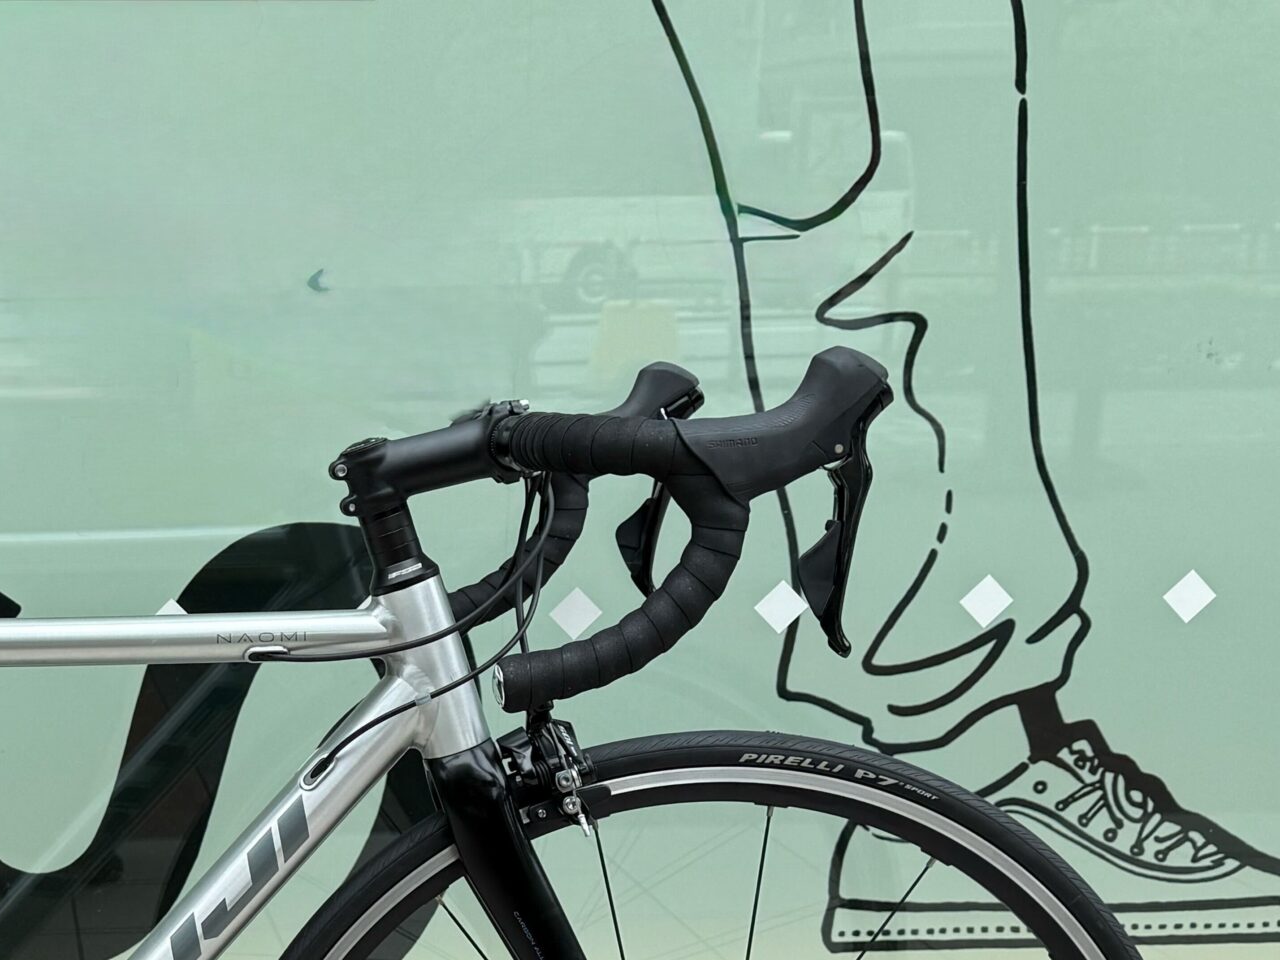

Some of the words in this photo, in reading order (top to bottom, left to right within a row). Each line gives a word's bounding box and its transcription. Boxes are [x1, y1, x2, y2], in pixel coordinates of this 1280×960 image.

[216, 631, 307, 645] NAOMI
[738, 752, 846, 773] PIRELLI
[904, 783, 940, 801] SPORT
